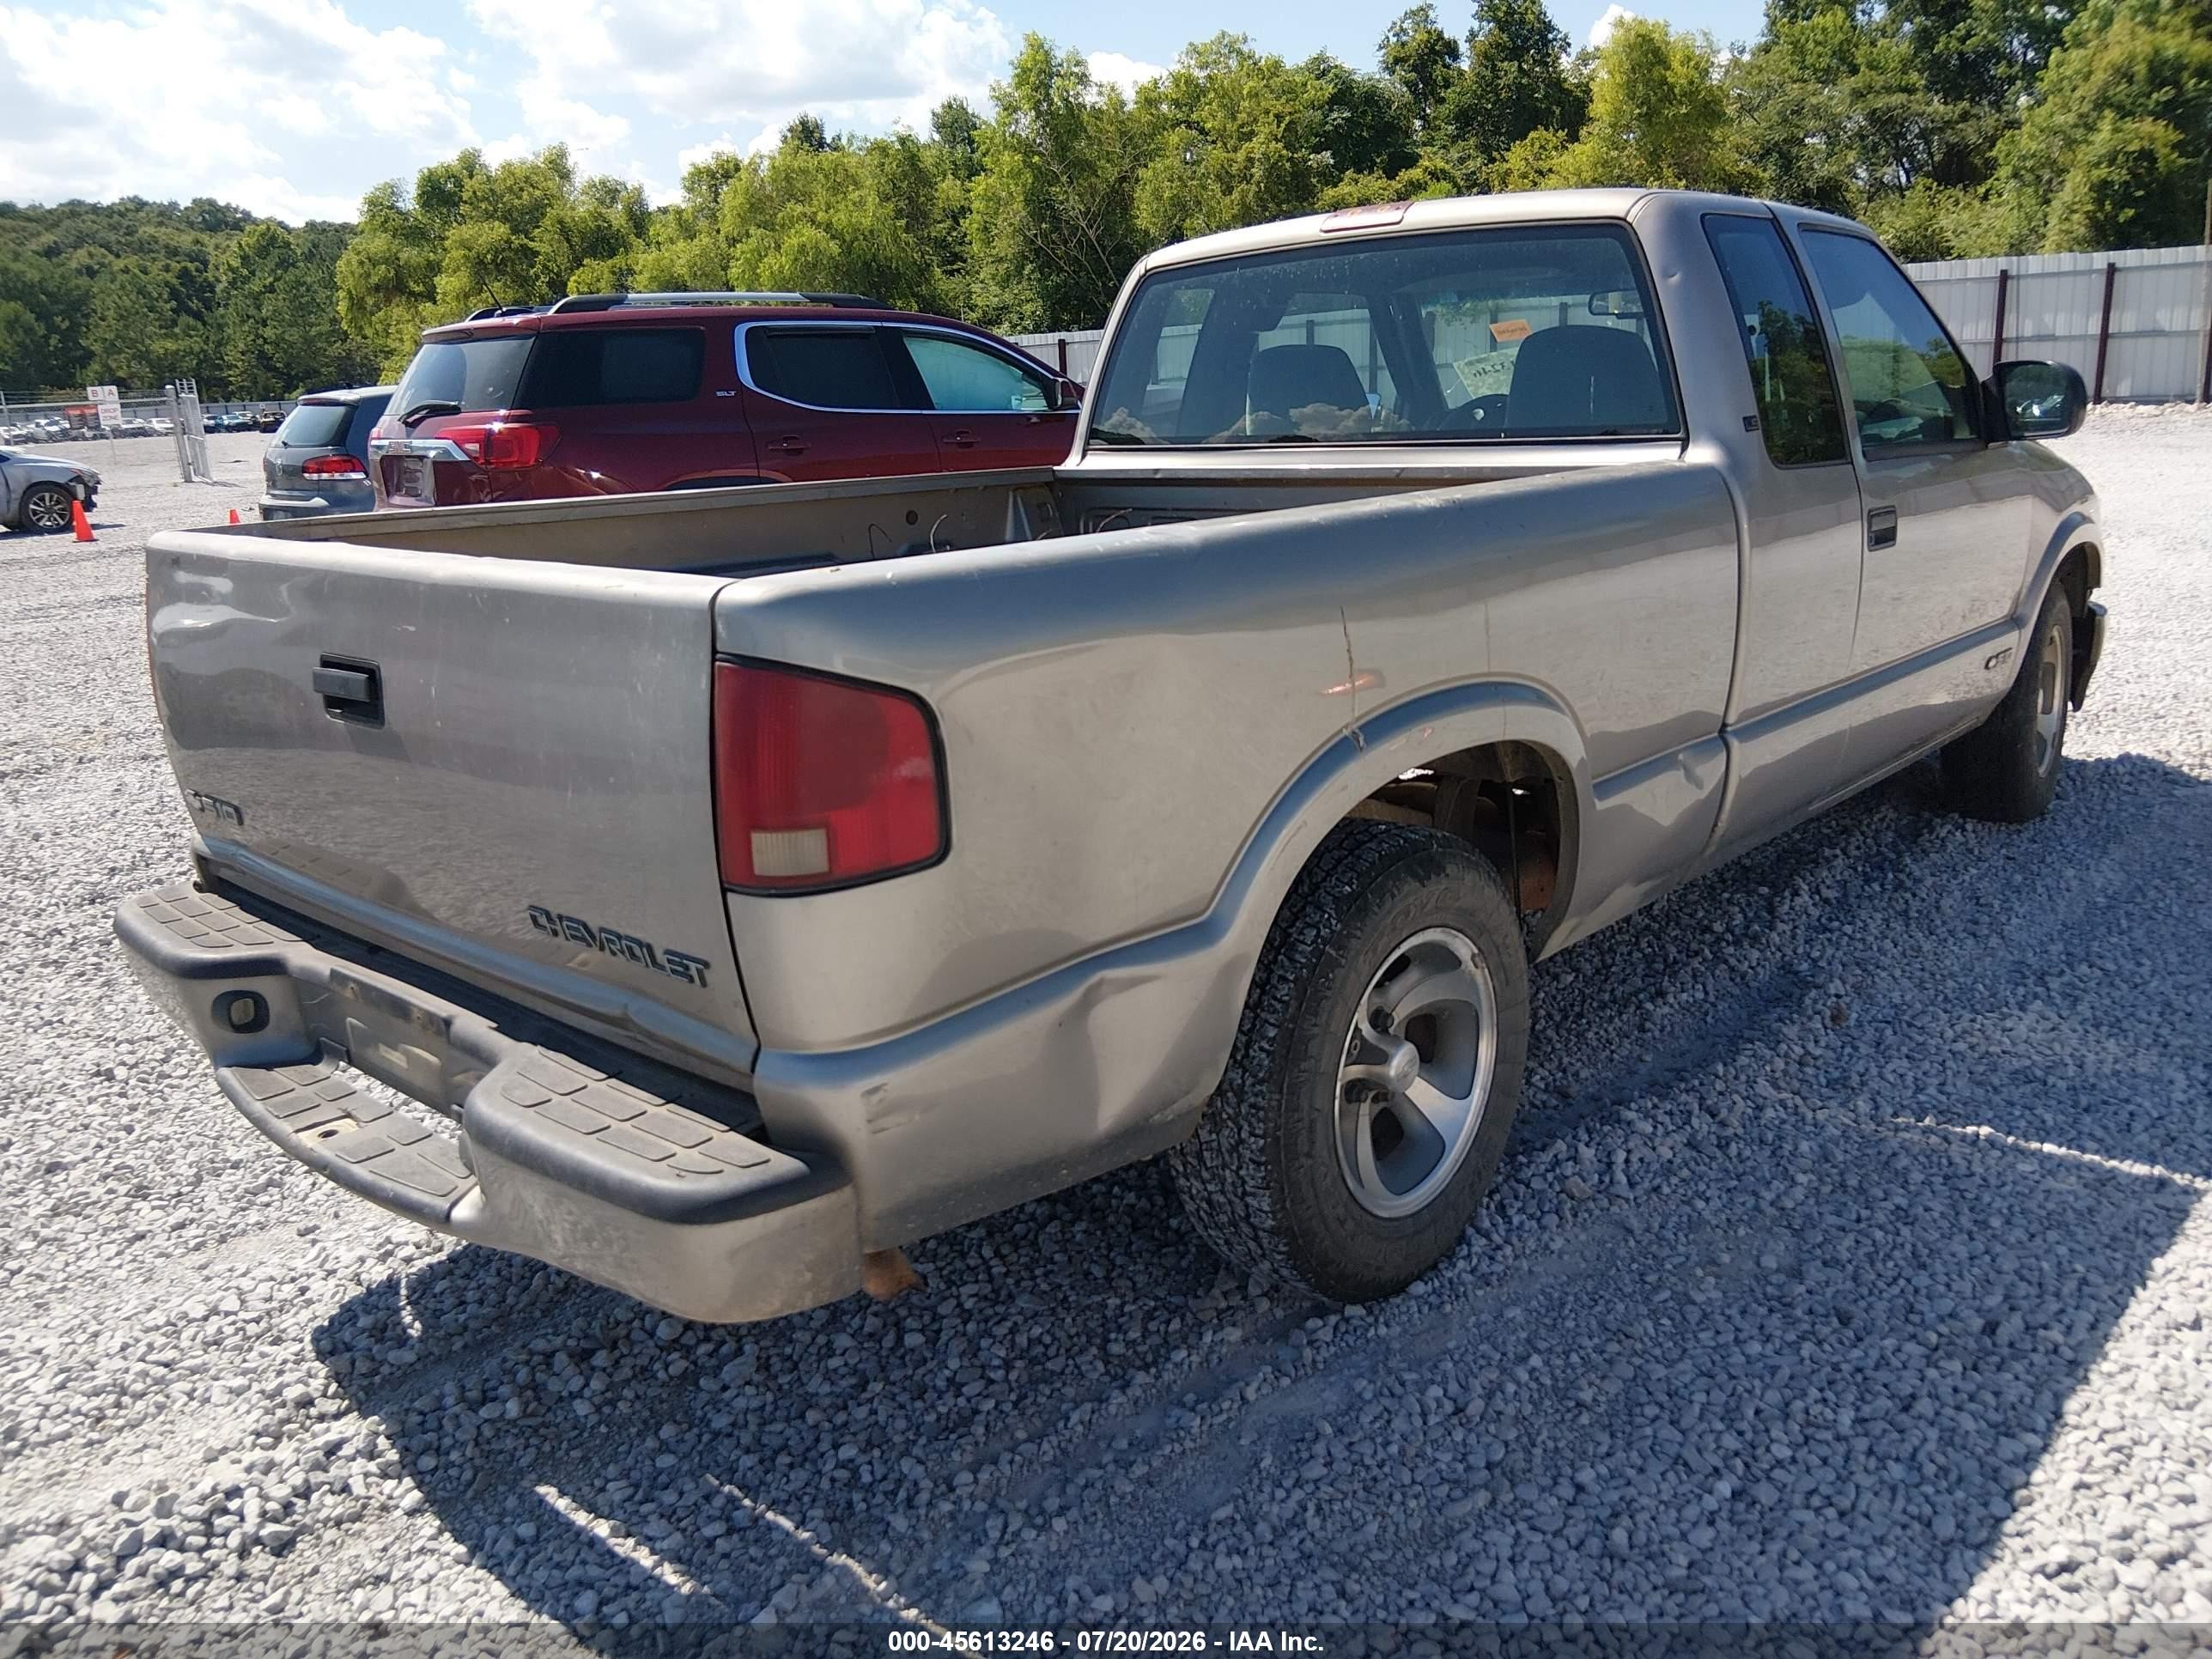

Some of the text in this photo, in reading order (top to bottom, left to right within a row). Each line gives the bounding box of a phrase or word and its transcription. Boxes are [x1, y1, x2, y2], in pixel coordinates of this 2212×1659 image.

[90, 388, 115, 398] B A
[527, 904, 711, 988] CHEVROLET
